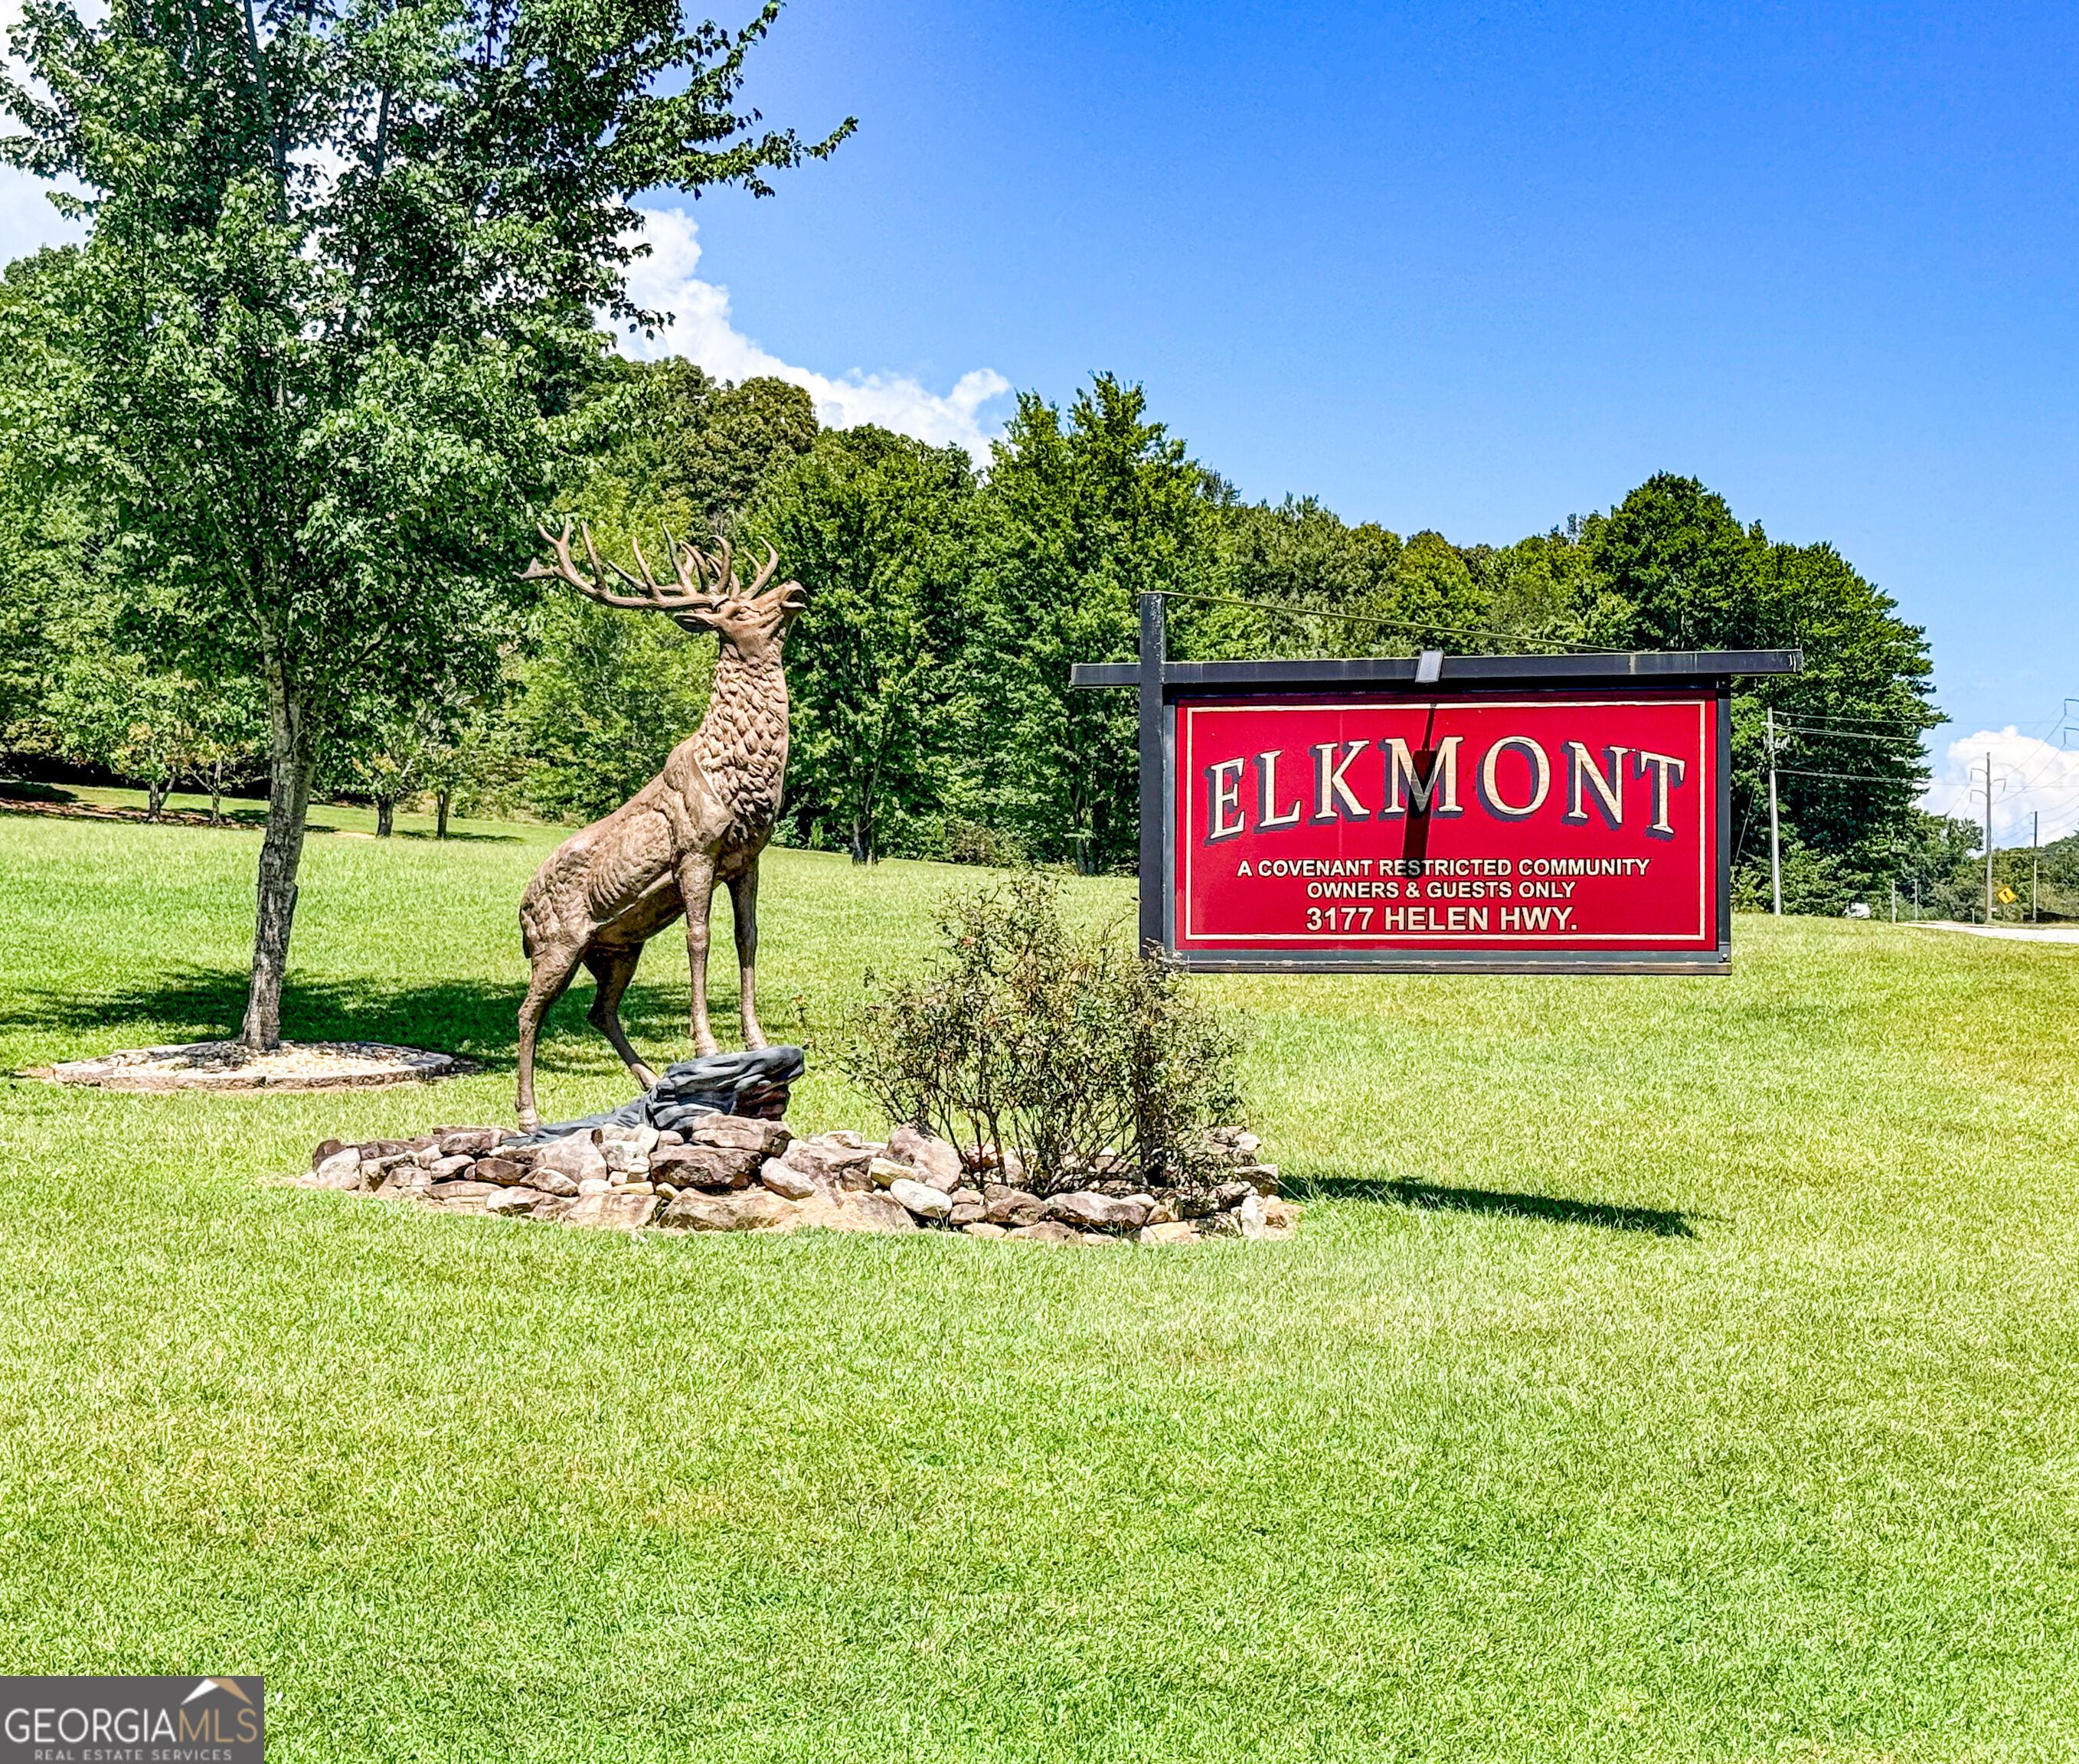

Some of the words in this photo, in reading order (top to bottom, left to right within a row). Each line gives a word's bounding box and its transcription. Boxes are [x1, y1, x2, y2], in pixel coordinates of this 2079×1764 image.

[1205, 735, 1686, 845] ELKMONT
[1236, 859, 1254, 877] A
[1257, 859, 1374, 877] COVENANT
[1379, 858, 1512, 877] RESTRICTED
[1518, 858, 1650, 877] COMMUNITY
[1306, 881, 1400, 899] OWNERS
[1404, 881, 1421, 899] &
[1426, 880, 1513, 899] GUESTS
[1518, 880, 1577, 899] ONLY
[1306, 906, 1375, 932] 3177
[1384, 906, 1489, 931] HELEN
[1499, 906, 1579, 931] HWY.
